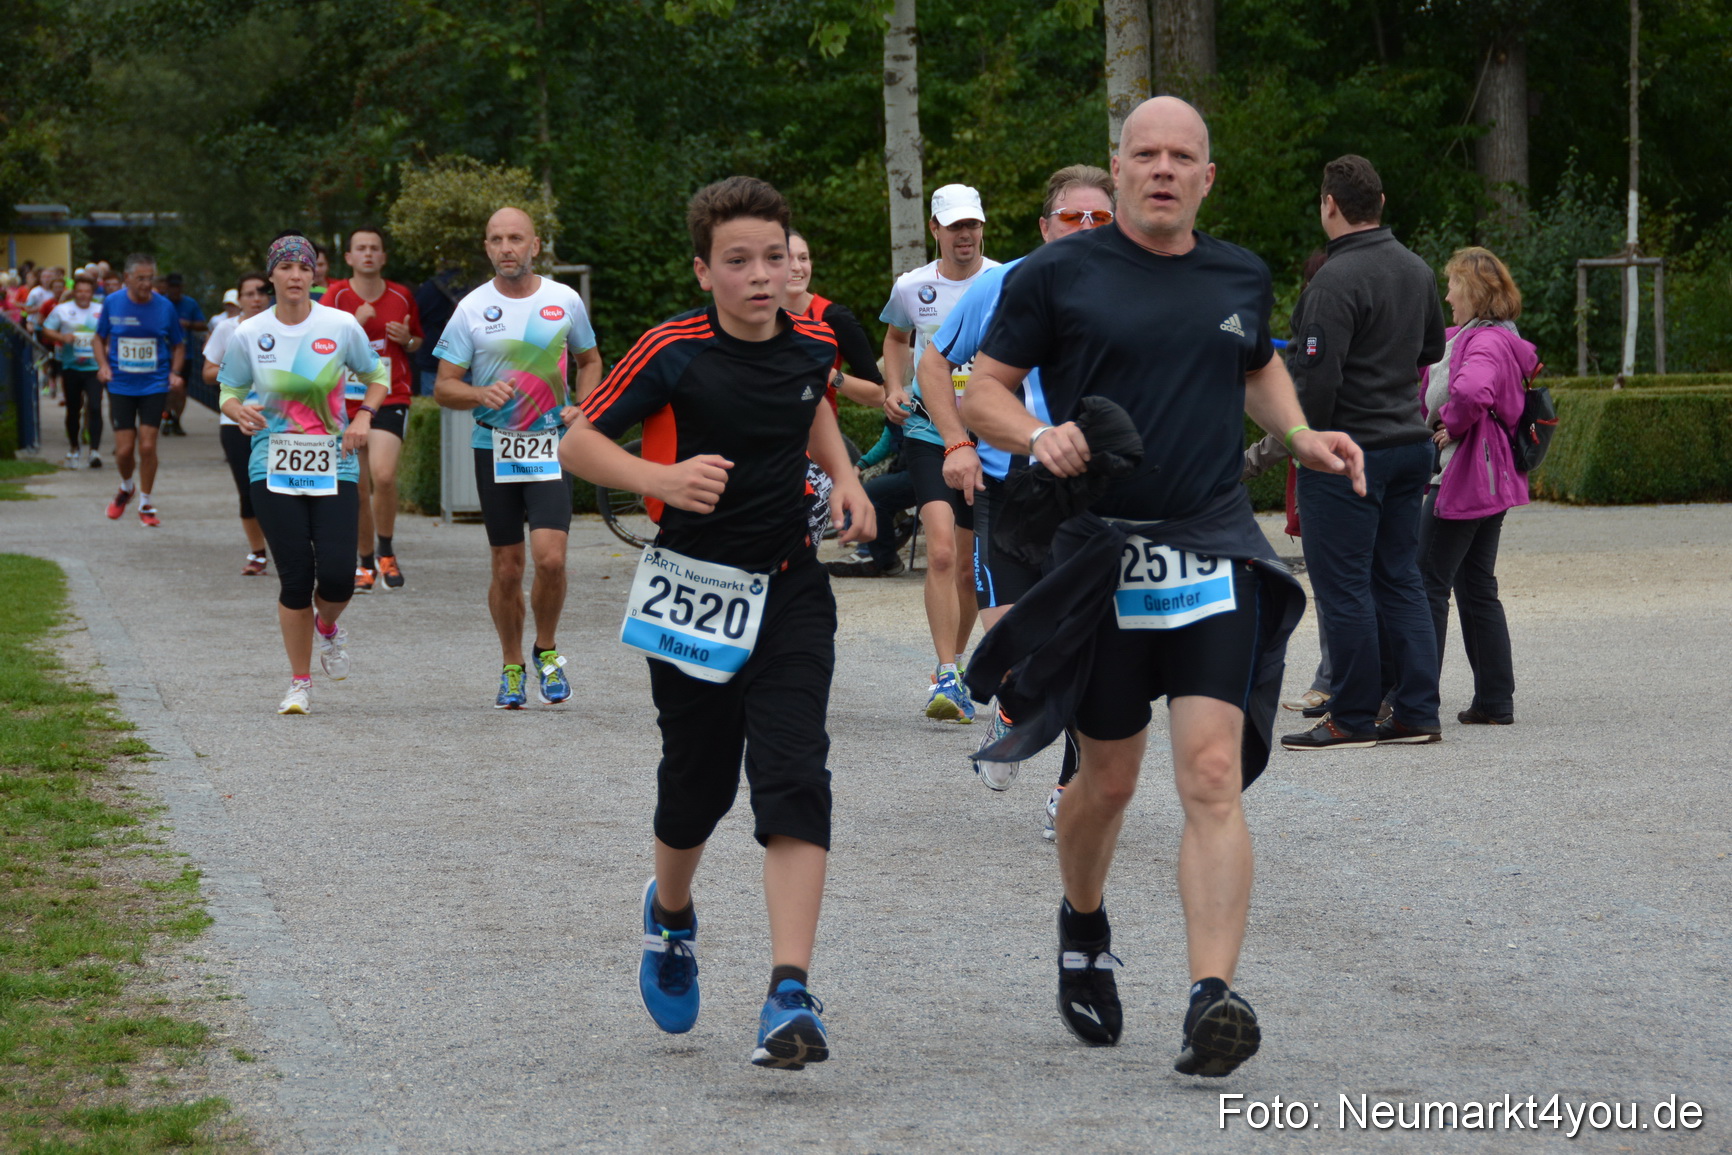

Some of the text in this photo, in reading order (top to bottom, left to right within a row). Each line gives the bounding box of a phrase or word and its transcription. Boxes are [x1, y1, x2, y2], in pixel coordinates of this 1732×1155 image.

[485, 323, 506, 331] PARTL
[122, 346, 153, 360] 3109
[270, 439, 292, 447] PARTL
[500, 437, 554, 460] 2624
[275, 449, 330, 472] 2623
[511, 464, 544, 473] Thomas
[289, 477, 315, 487] Katrin
[643, 553, 745, 592] PARTL Neumarkt
[641, 575, 750, 640] 2520
[1143, 591, 1201, 611] Guenter
[658, 633, 710, 662] Marko
